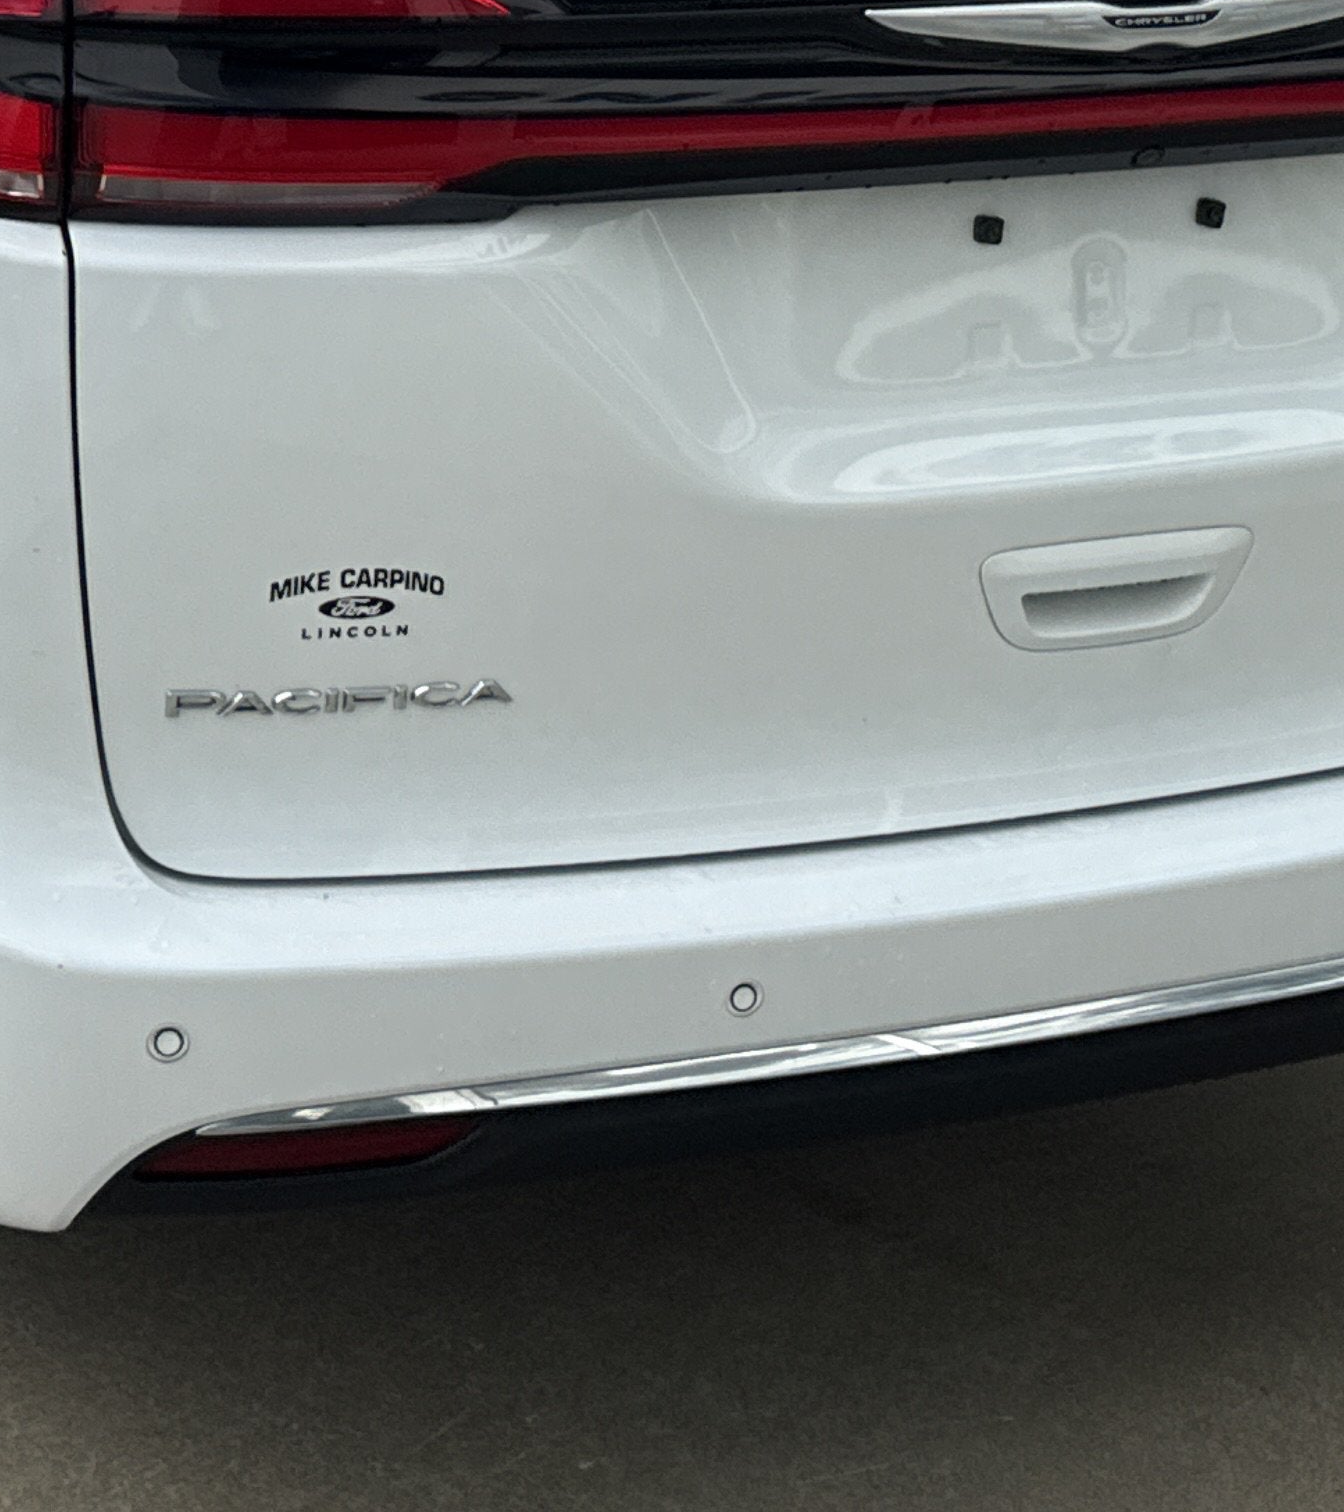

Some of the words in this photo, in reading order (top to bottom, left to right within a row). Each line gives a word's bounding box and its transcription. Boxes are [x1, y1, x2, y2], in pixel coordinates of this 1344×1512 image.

[1115, 13, 1207, 26] CHRYSLER
[268, 570, 331, 602] MIKE
[340, 568, 445, 596] CARPINO
[326, 597, 388, 618] Ford
[301, 624, 409, 640] LINCOLN
[163, 678, 513, 719] PACIFICA
